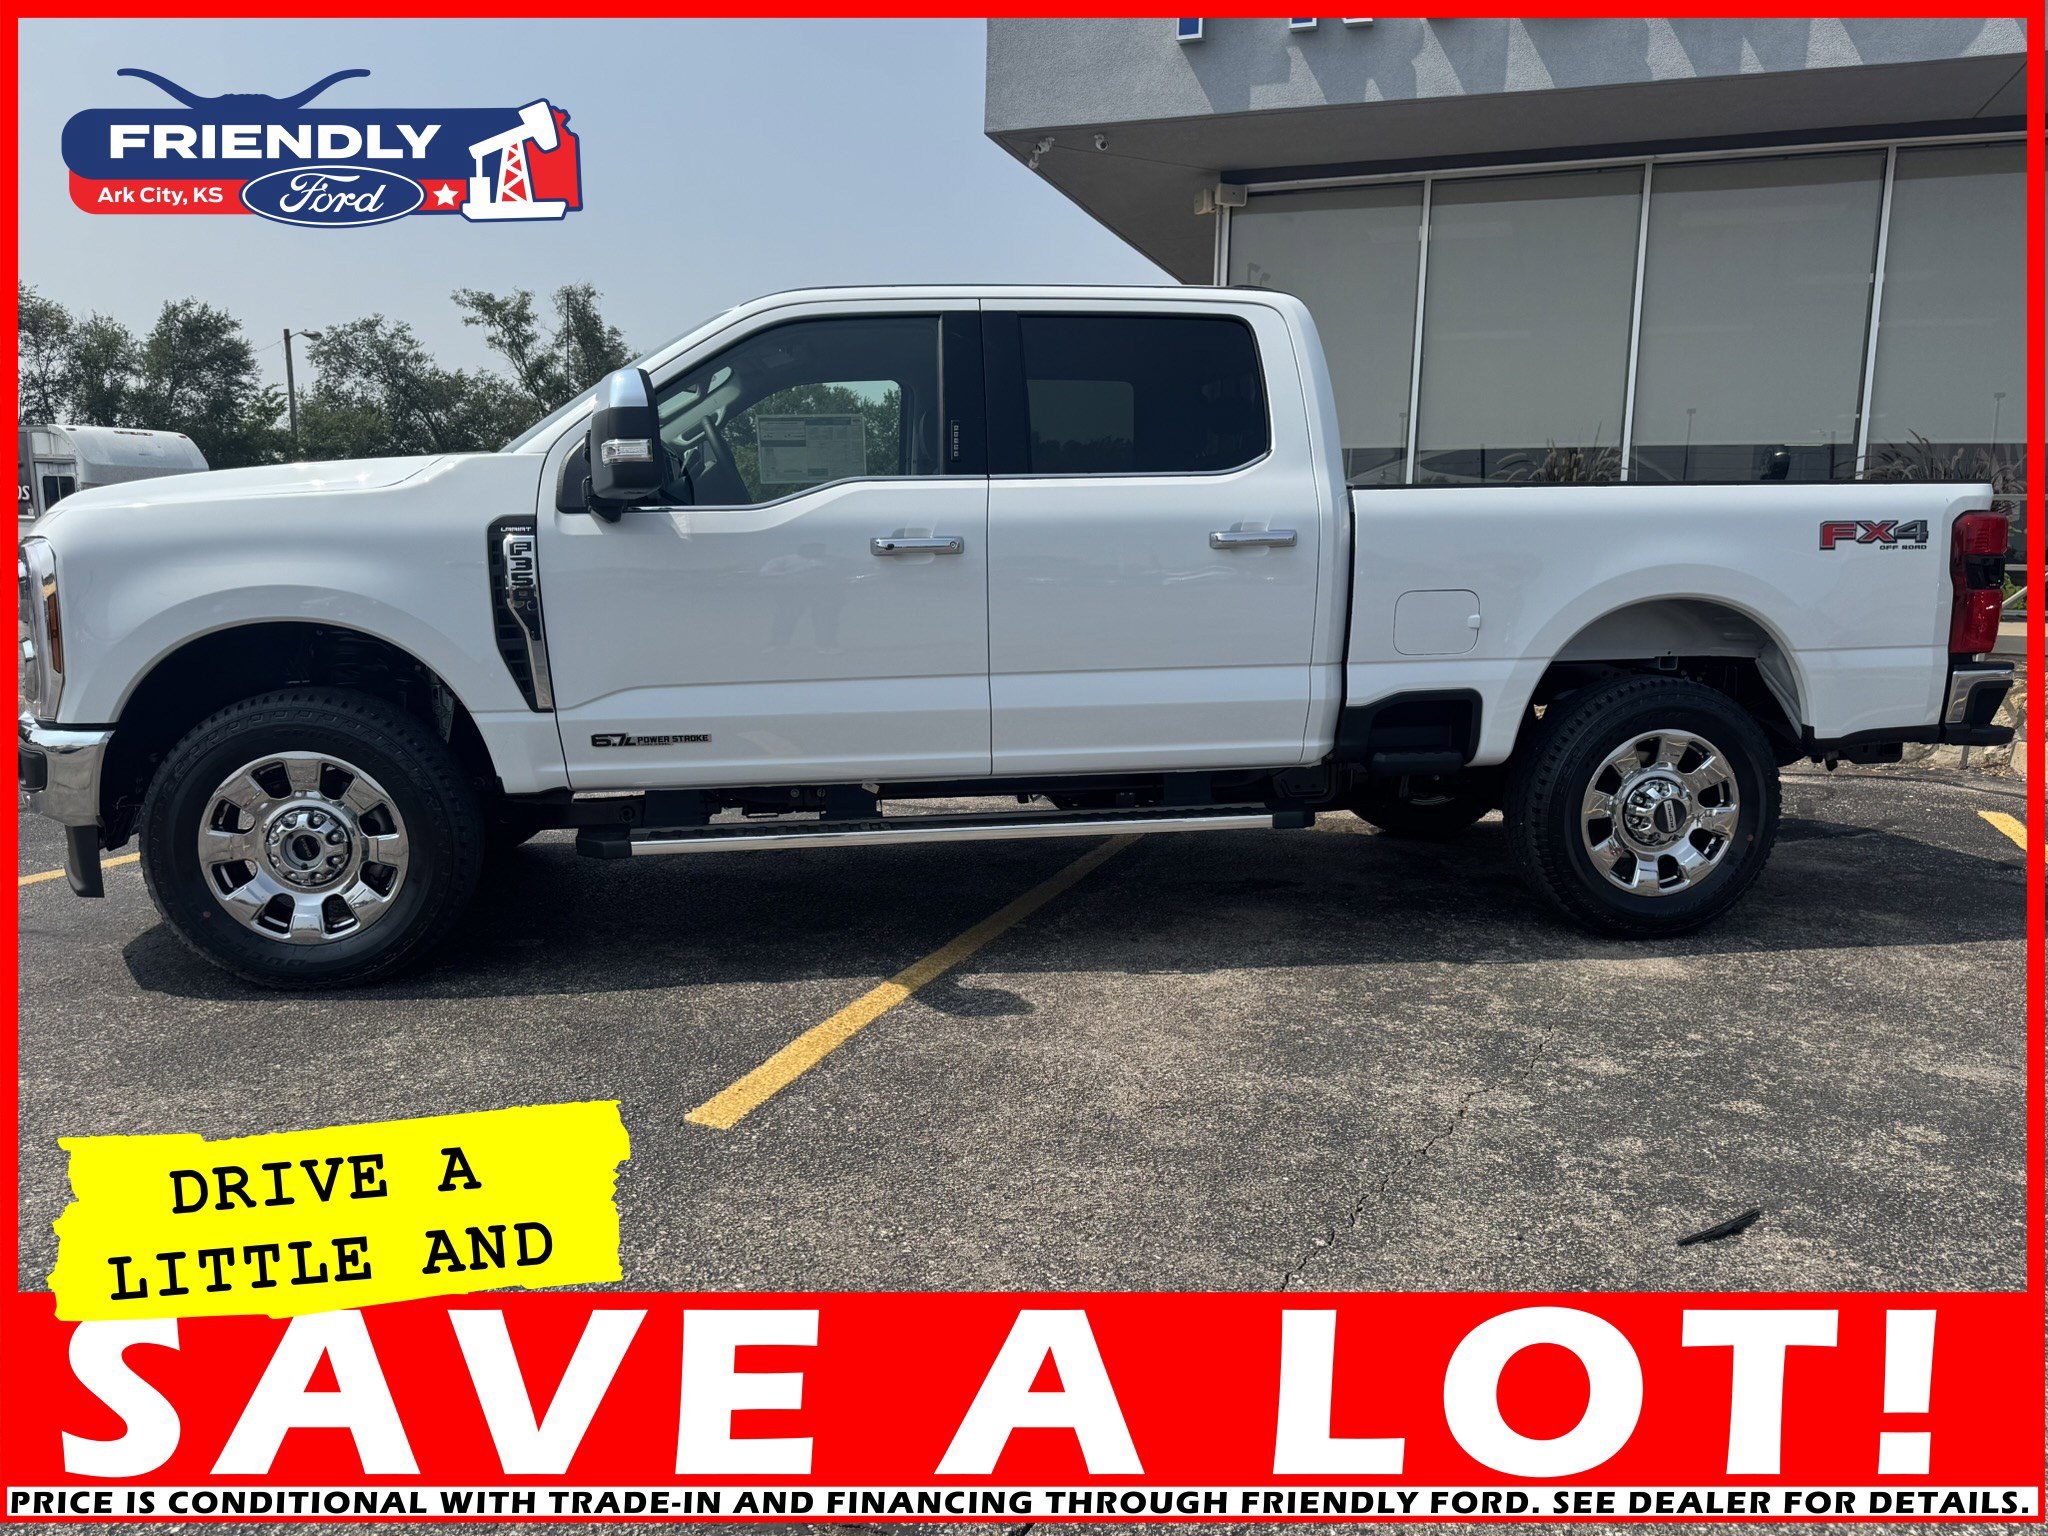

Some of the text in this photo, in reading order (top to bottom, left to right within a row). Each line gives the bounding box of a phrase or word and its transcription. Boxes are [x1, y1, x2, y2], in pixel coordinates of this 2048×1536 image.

[1819, 519, 1929, 551] FX4
[591, 732, 710, 748] 6.7L POWER STROKE
